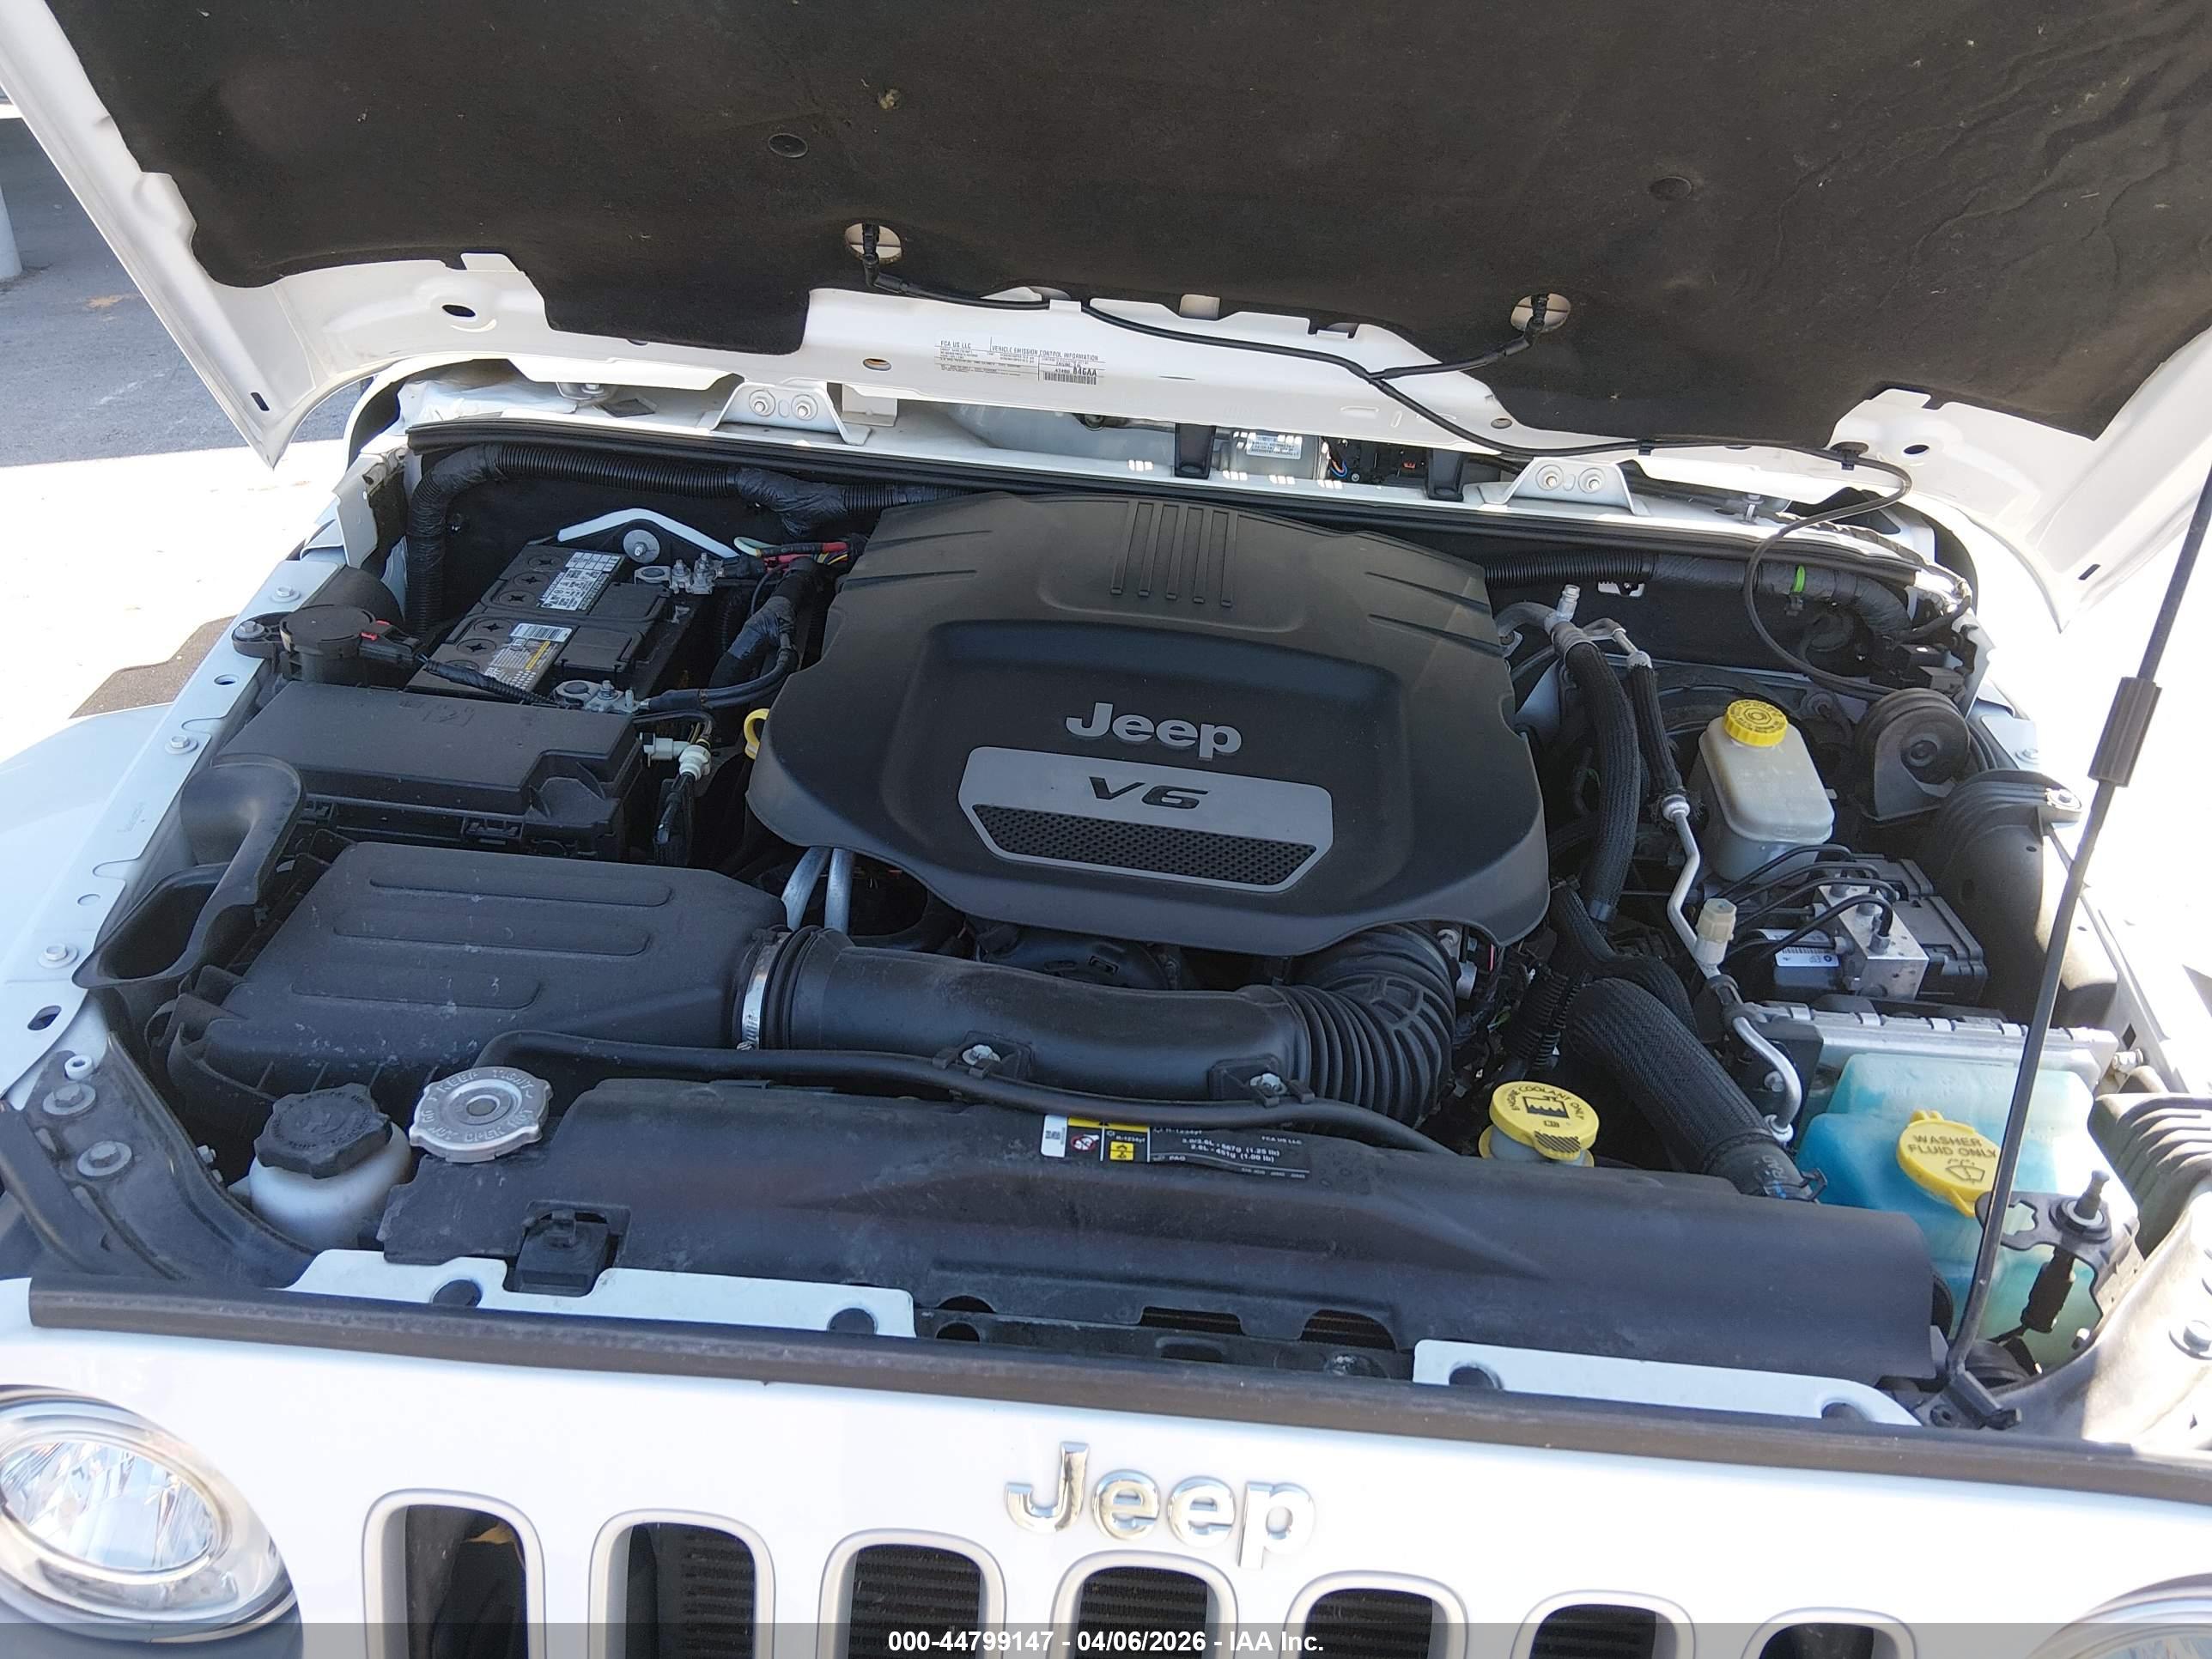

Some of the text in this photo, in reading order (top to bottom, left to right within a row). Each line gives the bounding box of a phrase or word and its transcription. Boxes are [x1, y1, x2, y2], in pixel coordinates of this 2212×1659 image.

[1013, 347, 1038, 356] EMISSION
[1064, 352, 1099, 361] INFORMATION
[1065, 702, 1243, 761] Jeep
[1088, 776, 1209, 810] V6
[437, 1070, 482, 1093] KEEP
[1518, 1085, 1571, 1101] COOLANT
[1570, 1102, 1585, 1121] ONLY
[1908, 1144, 1997, 1158] FLUID ONLY
[1912, 1134, 1983, 1147] WASHER
[1005, 1442, 1316, 1570] Jeep
